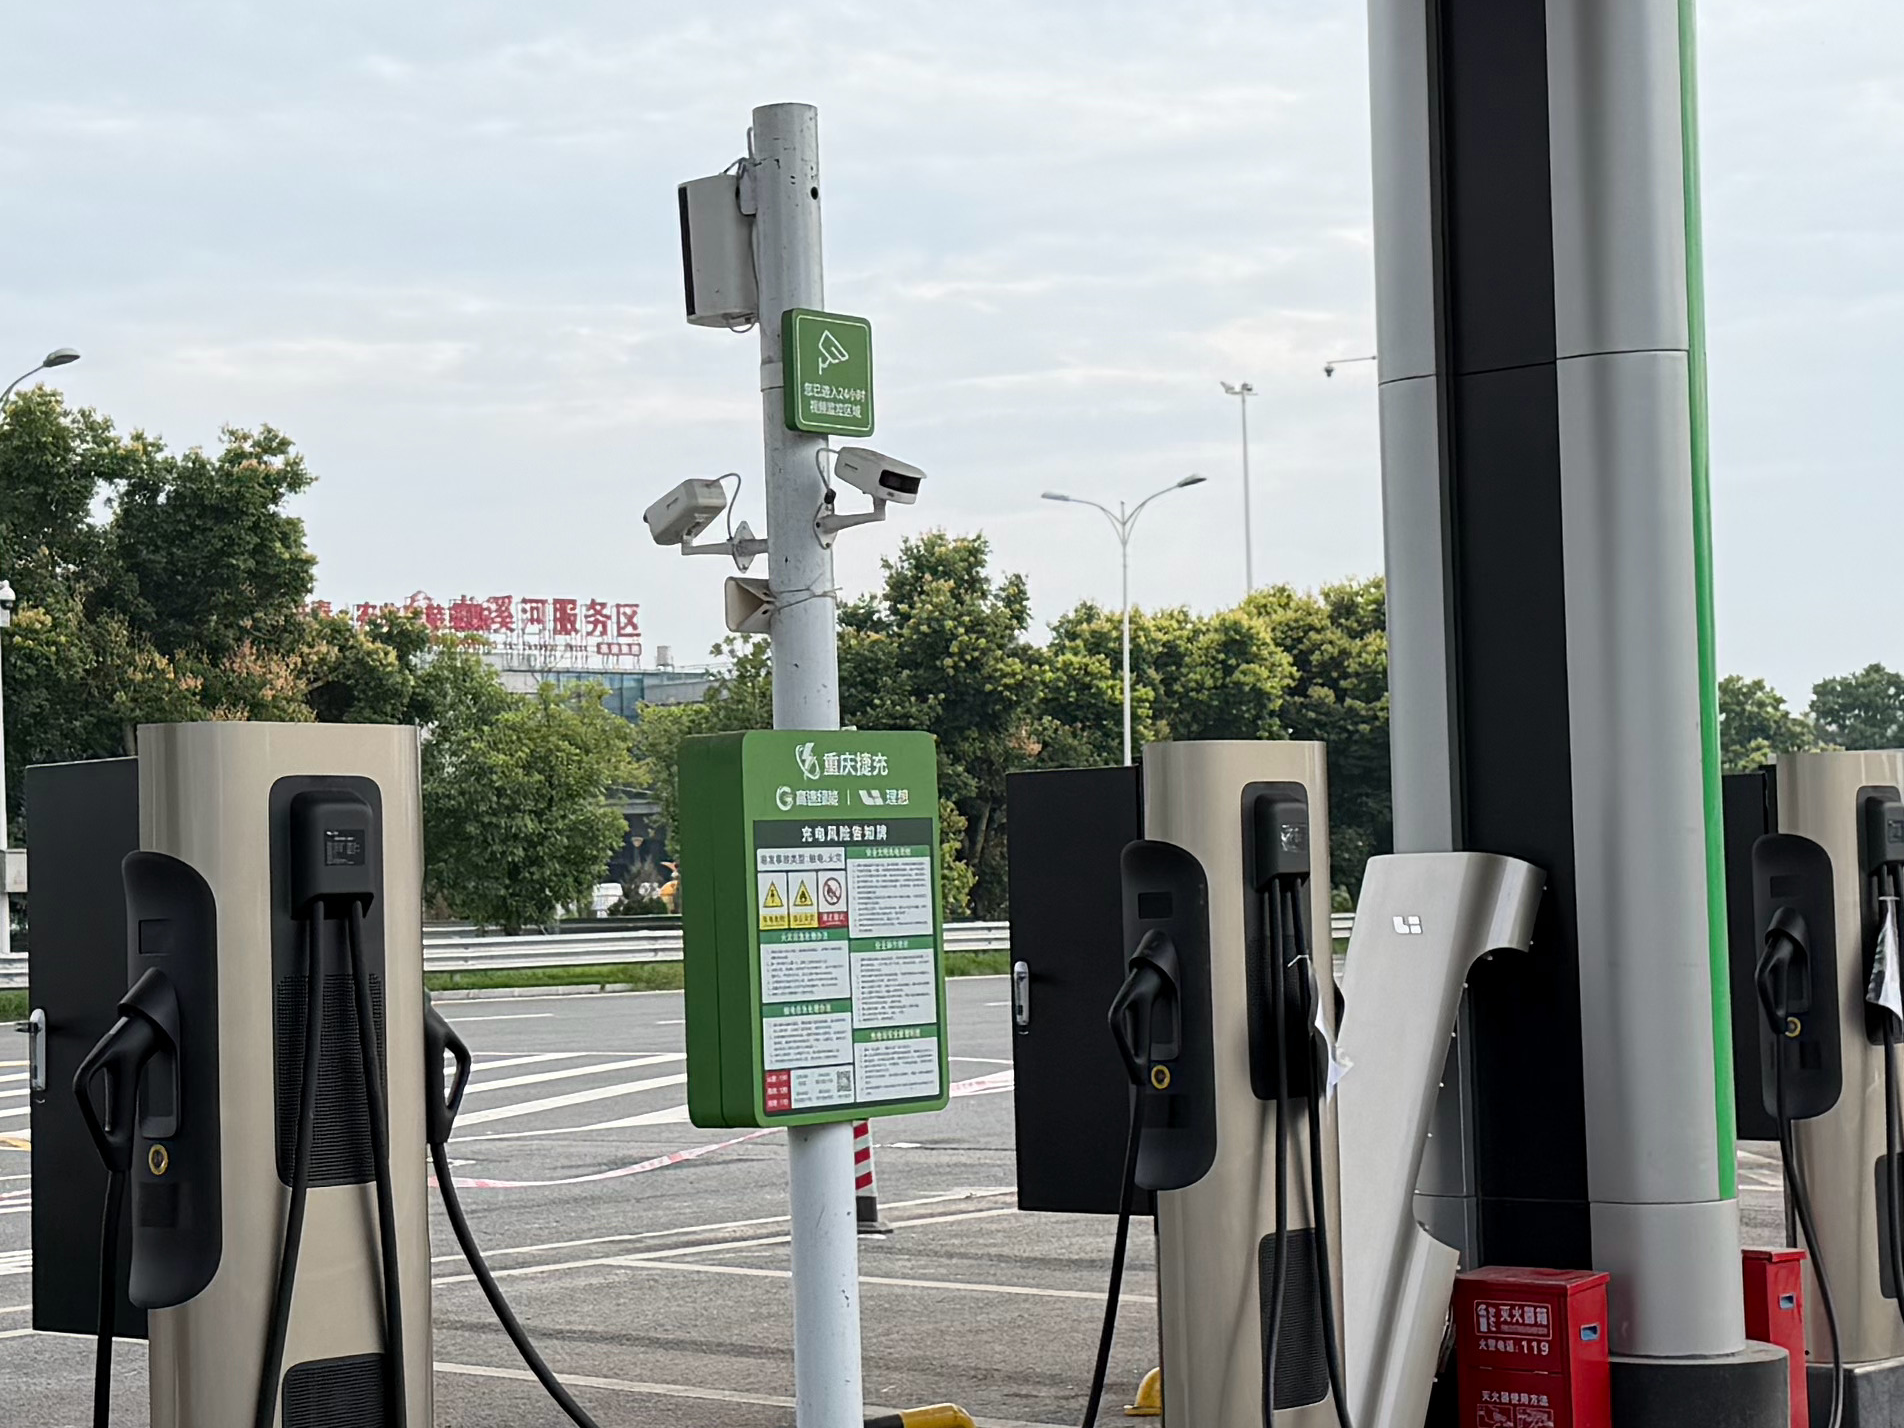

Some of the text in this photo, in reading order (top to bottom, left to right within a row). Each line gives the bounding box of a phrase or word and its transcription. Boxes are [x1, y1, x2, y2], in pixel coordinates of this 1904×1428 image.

[823, 752, 888, 776] 重庆捷充
[801, 825, 887, 842] 充电风险告知牌
[1499, 1305, 1547, 1324] 灭火器箱
[1482, 1390, 1549, 1406] 灭火器使用方法
